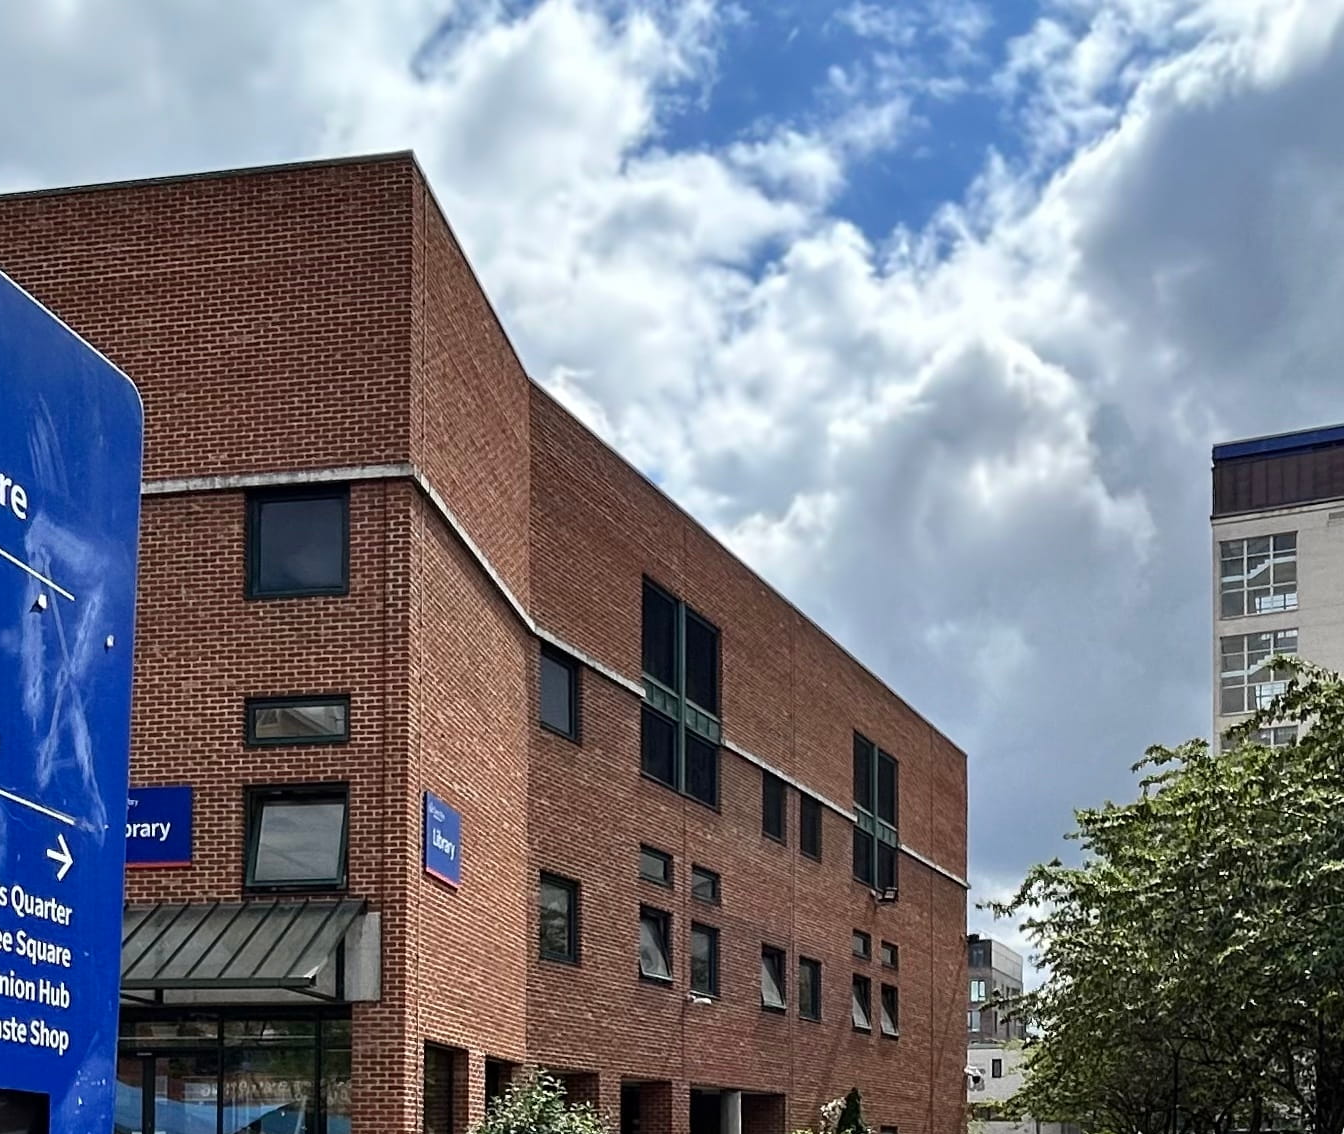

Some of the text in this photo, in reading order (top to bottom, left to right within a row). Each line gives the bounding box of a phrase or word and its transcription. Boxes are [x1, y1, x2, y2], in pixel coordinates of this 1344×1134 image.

[432, 827, 456, 861] Library
[11, 884, 73, 926] Quarter
[16, 929, 72, 968] Square
[38, 976, 70, 1009] Hub
[29, 1019, 70, 1056] Shop
